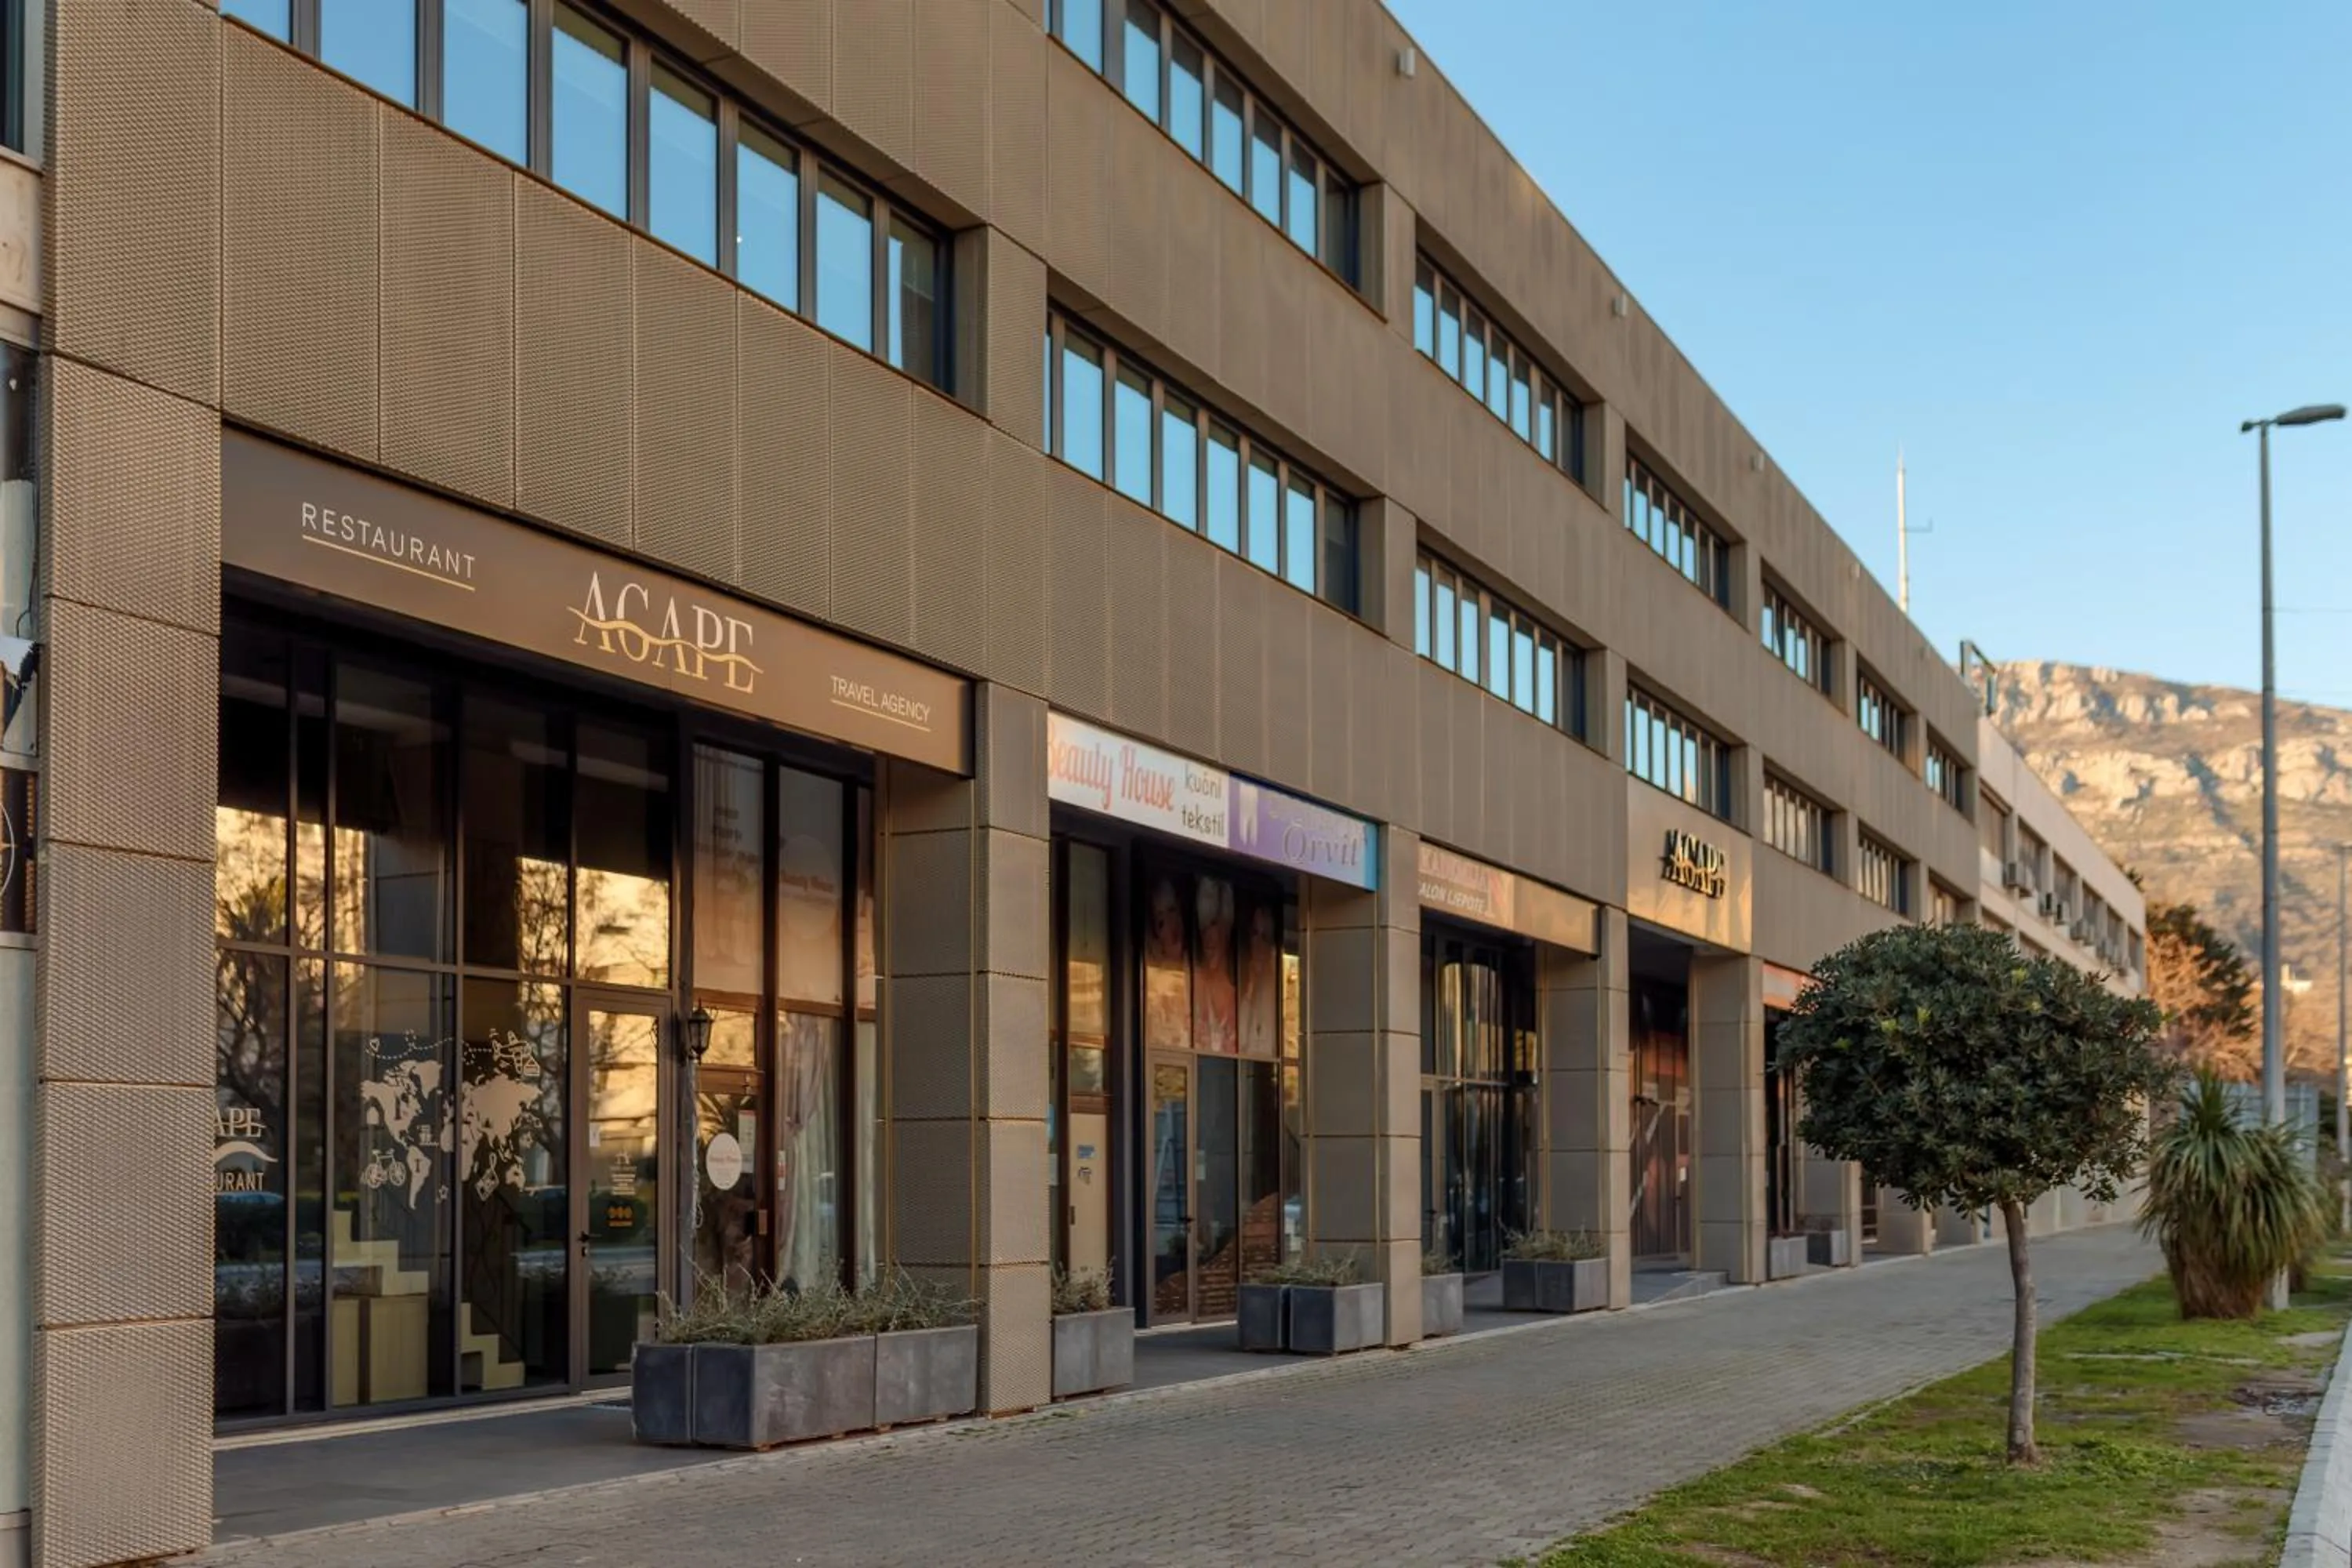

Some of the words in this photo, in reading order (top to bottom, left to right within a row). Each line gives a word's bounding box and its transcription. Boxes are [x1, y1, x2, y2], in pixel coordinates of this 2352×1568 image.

[302, 501, 476, 579] RESTAURANT
[830, 675, 879, 707] TRAVEL
[880, 692, 931, 723] AGENCY
[1120, 743, 1175, 812] House
[1181, 803, 1225, 837] tekstil
